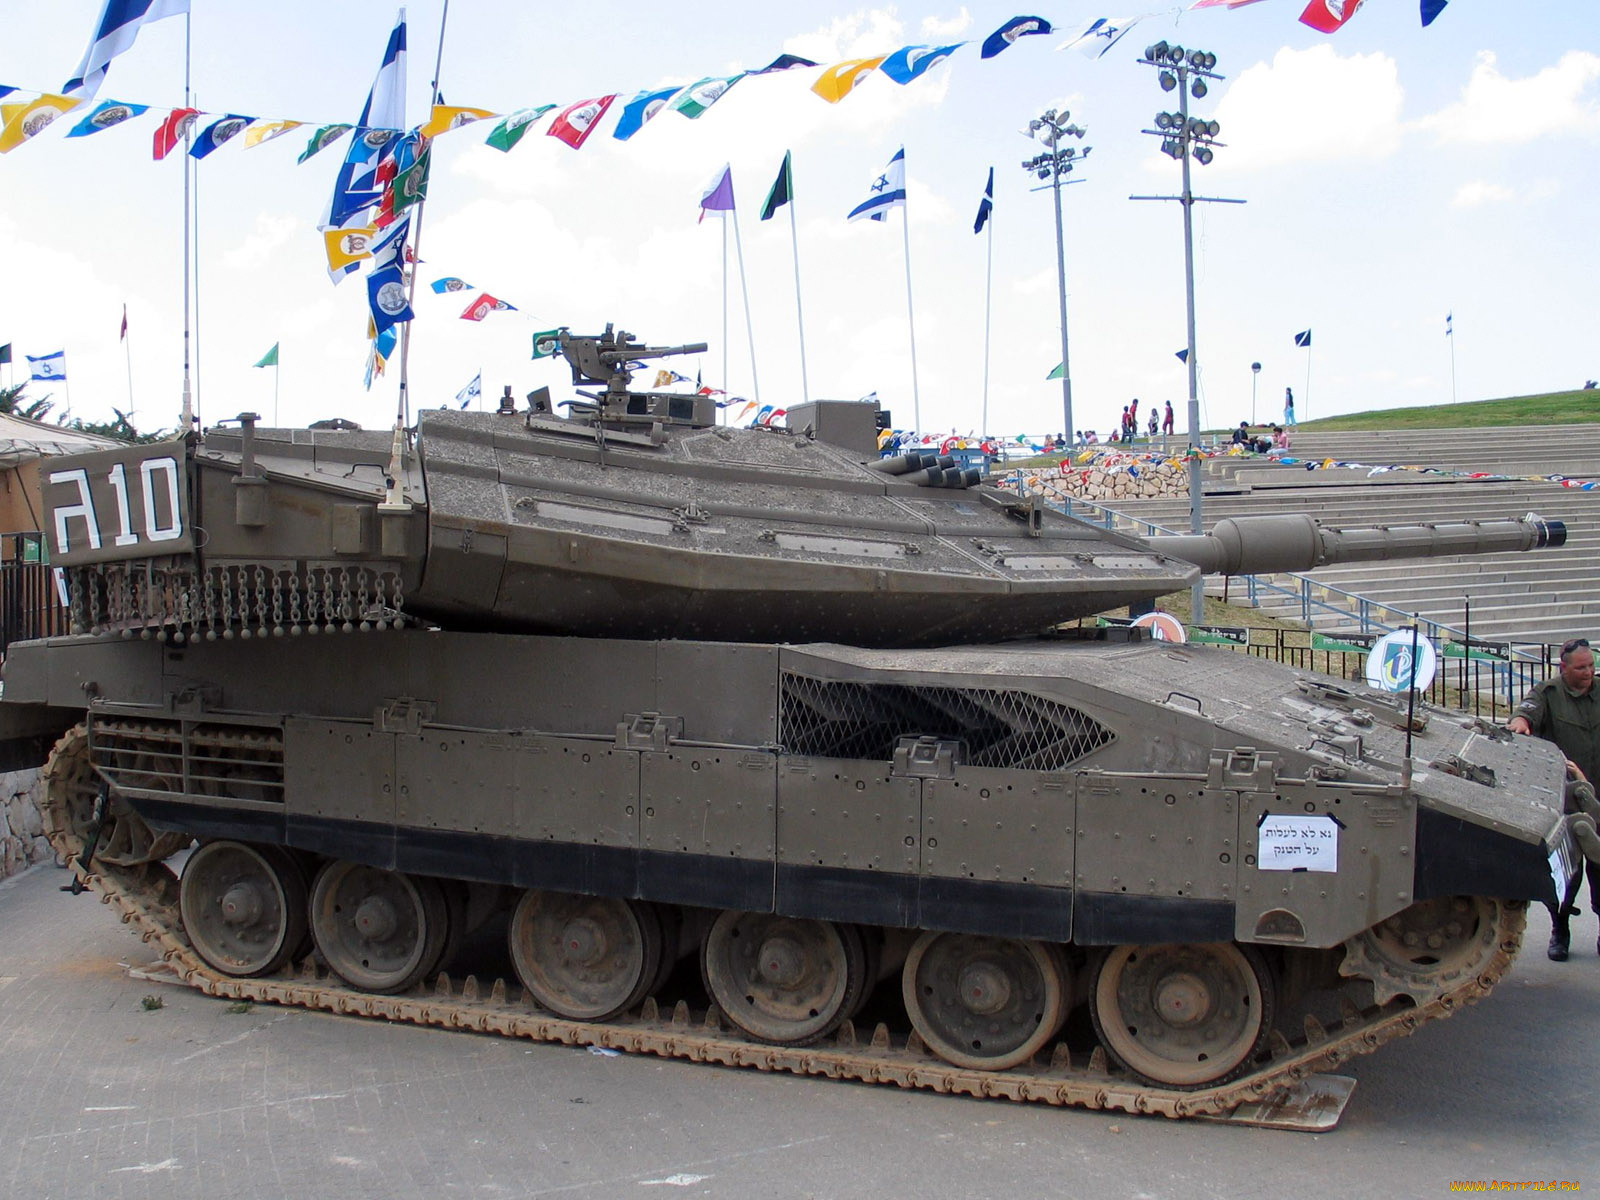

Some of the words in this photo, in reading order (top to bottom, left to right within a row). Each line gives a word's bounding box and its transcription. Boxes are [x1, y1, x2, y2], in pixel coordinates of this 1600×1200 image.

[1265, 825, 1297, 838] לעלות
[1301, 826, 1316, 838] לא
[1319, 829, 1332, 838] נא
[1273, 846, 1302, 858] הטנק
[1304, 843, 1319, 855] על
